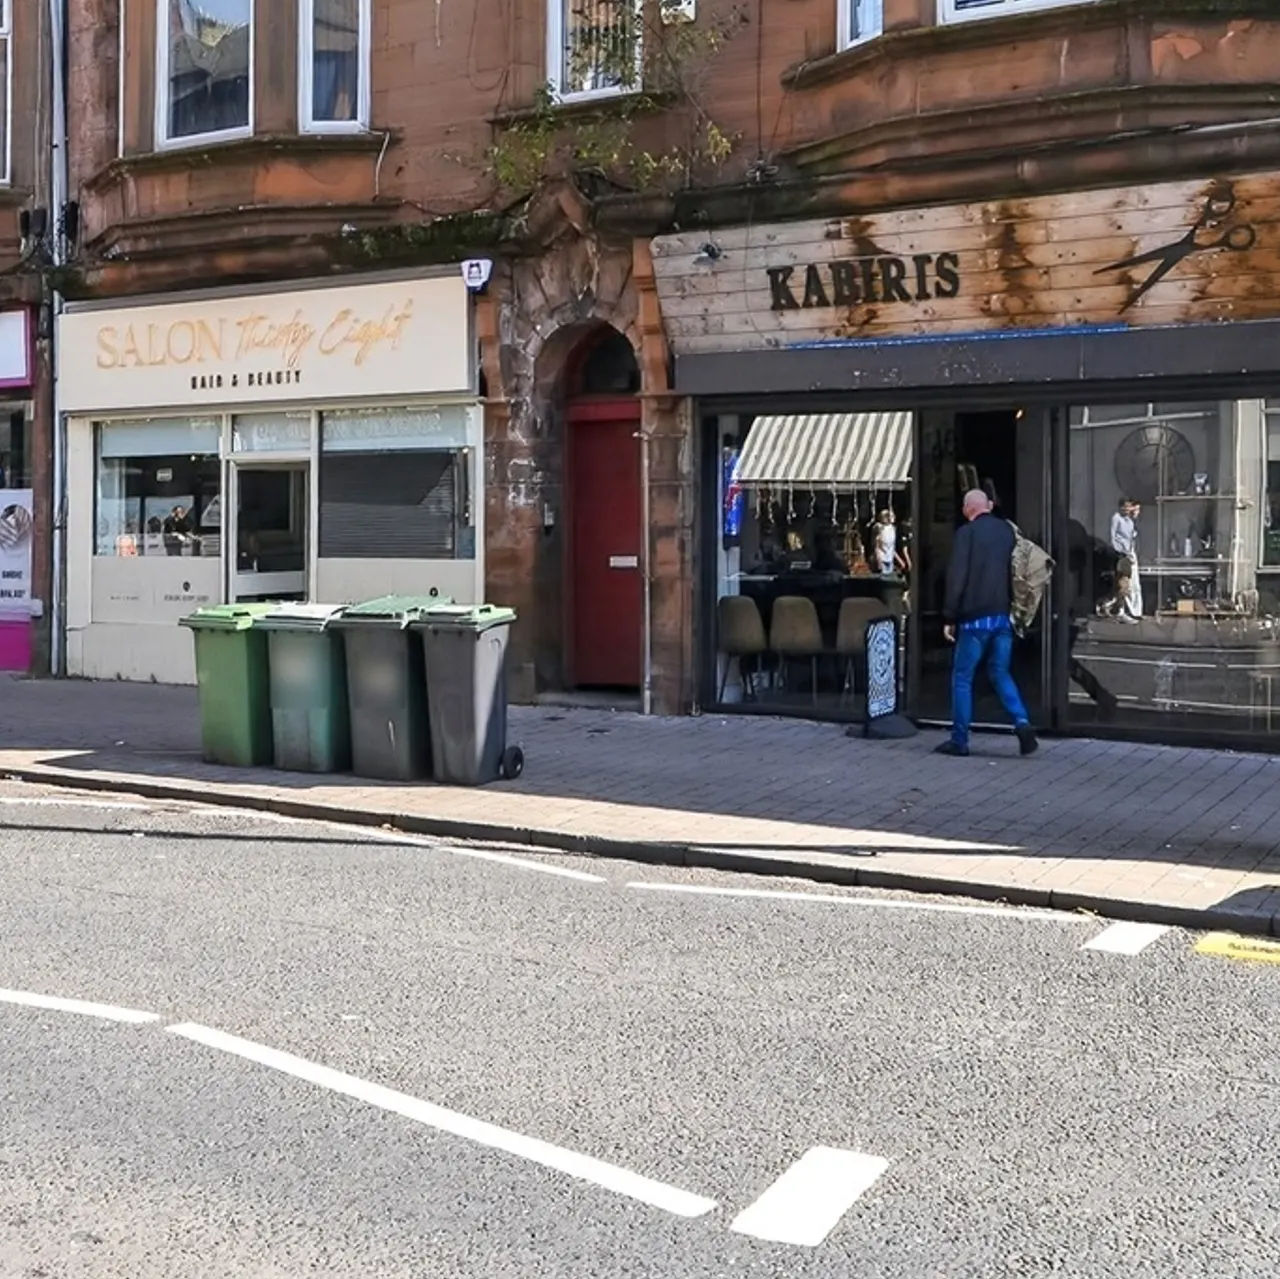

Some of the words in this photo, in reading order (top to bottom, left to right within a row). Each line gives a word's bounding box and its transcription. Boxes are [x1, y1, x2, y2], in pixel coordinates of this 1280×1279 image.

[767, 252, 960, 311] KABIRIS
[96, 318, 226, 370] SALON
[191, 375, 222, 390] HAIR
[231, 373, 239, 387] &
[248, 370, 301, 386] BEAUTY
